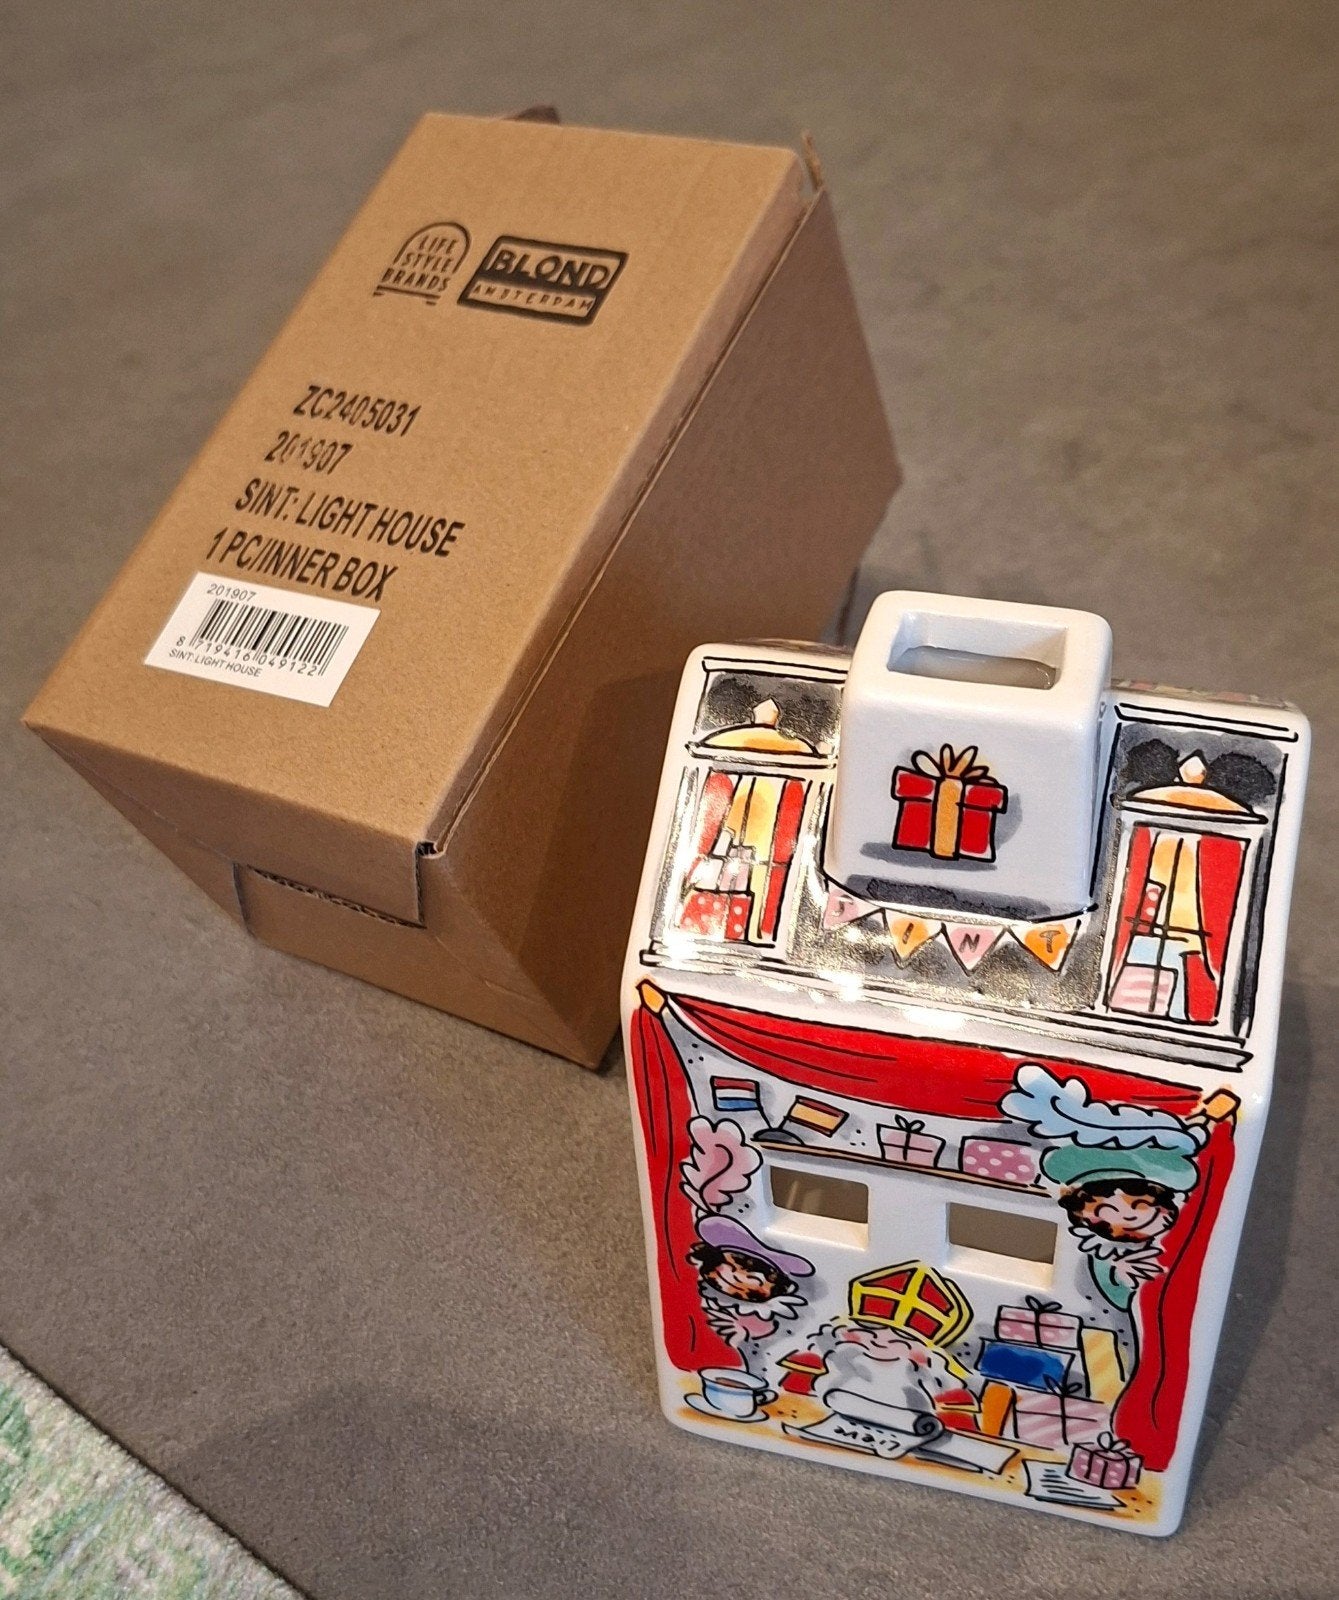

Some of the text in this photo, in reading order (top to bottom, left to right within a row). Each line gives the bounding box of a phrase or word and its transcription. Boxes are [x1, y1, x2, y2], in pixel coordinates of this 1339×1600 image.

[418, 235, 459, 251] LIFE
[401, 251, 453, 273] STYLE
[487, 249, 611, 287] BLOND
[380, 267, 451, 292] BRANDS
[473, 283, 593, 311] AMSTERDAM
[293, 384, 422, 437] ZC2405031
[264, 430, 353, 475] 201907
[235, 478, 466, 558] SINT: LIGHT HOUSE
[206, 526, 399, 602] 1 PC/INNER BOX
[206, 582, 257, 602] 201907
[176, 635, 321, 677] 8 719416 049122
[194, 653, 227, 669] LIGHT
[225, 661, 263, 678] HOUSE
